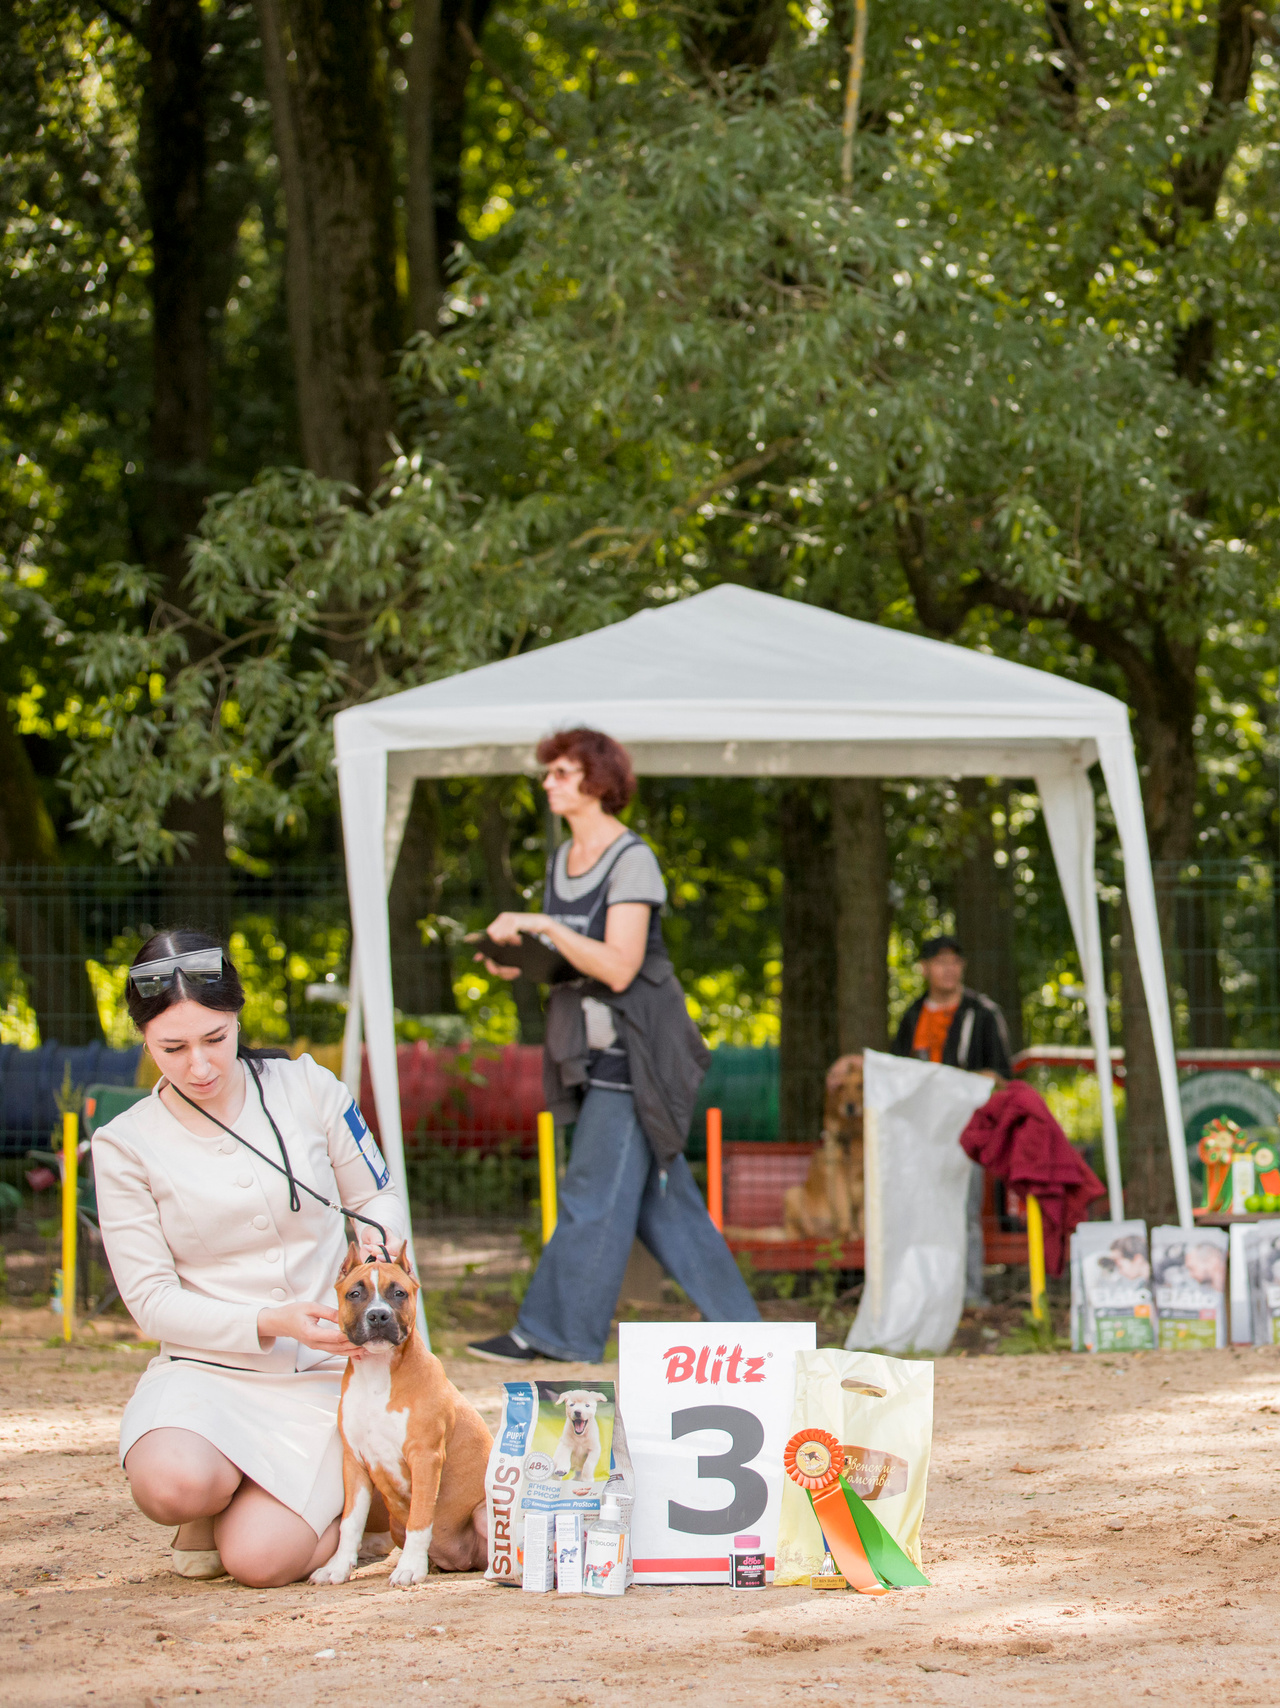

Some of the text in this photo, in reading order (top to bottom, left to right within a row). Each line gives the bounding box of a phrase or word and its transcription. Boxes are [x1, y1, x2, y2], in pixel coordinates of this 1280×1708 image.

[662, 1344, 767, 1385] Blitz
[506, 1431, 525, 1440] PUPPY
[529, 1461, 549, 1471] 48%
[668, 1404, 769, 1535] 3
[528, 1482, 562, 1493] ЯГНЕНОК
[533, 1490, 560, 1500] РИСОМ
[492, 1465, 521, 1575] SIRIUS
